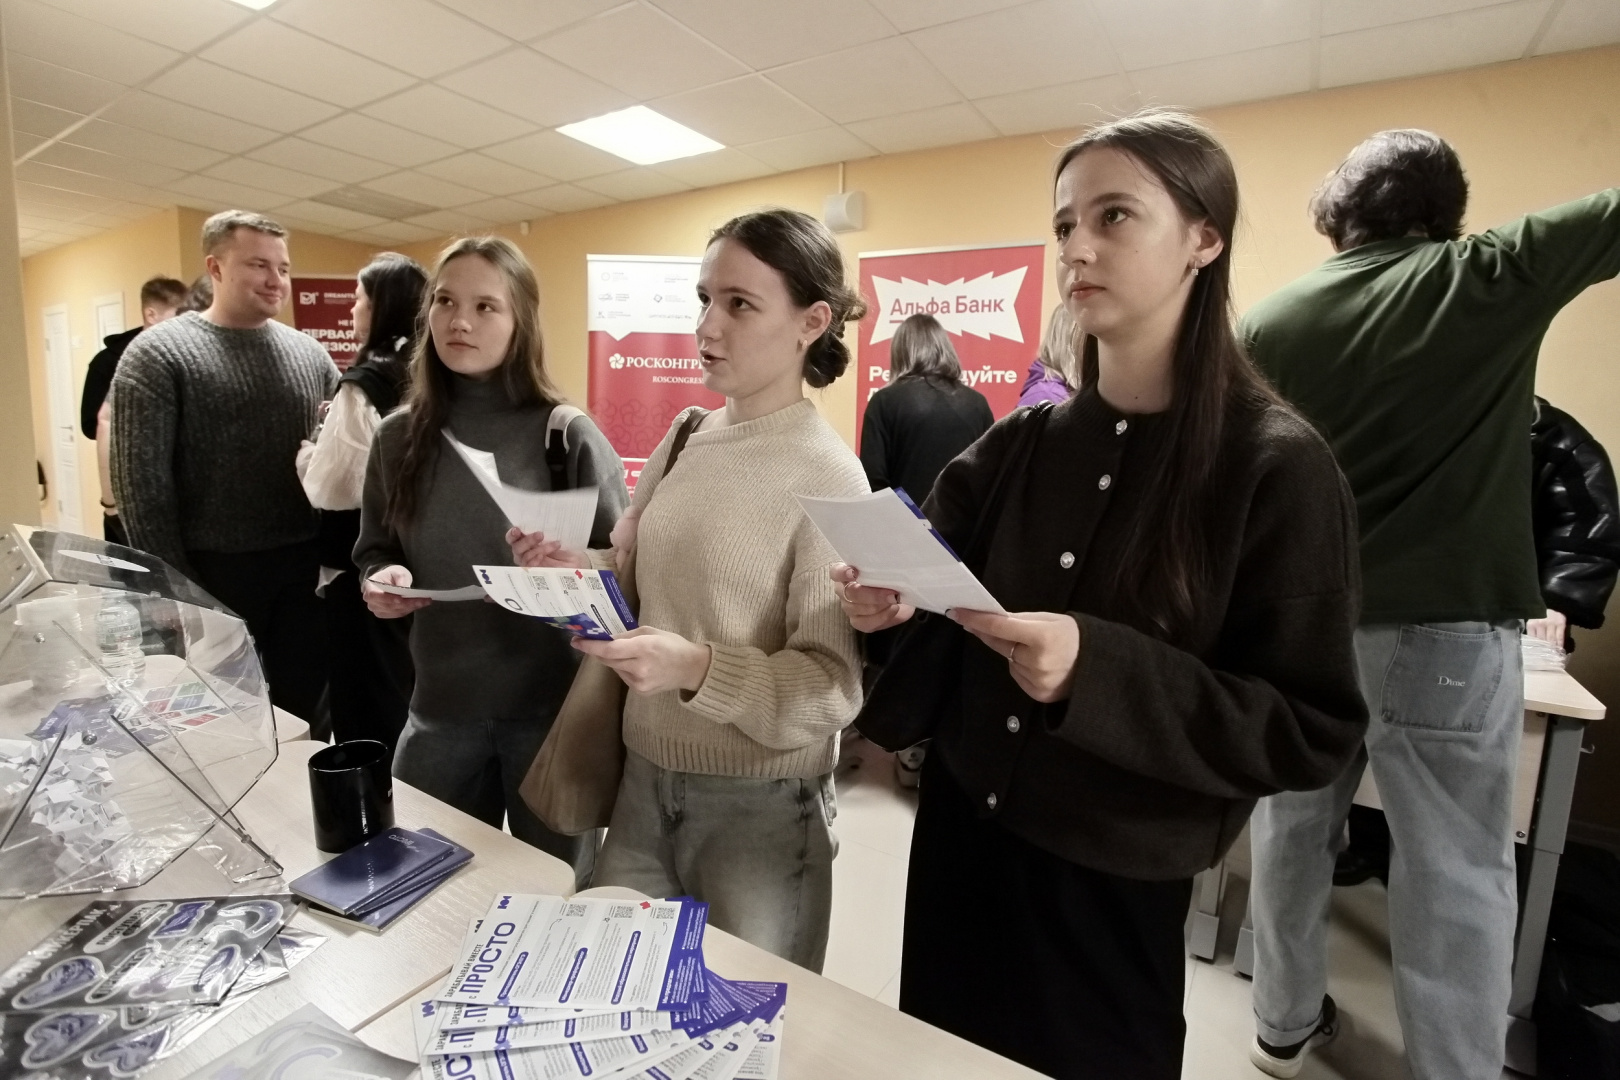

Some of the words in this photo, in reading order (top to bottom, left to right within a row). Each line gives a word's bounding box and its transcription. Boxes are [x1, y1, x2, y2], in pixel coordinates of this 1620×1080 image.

[890, 297, 950, 316] Альфа
[955, 295, 1005, 313] Банк
[323, 341, 362, 352] ЕЗЮМ
[1437, 675, 1466, 687] Dime
[458, 922, 517, 992] ПРОСТО
[444, 962, 473, 997] ЗАРАБАТЫВАЙ
[467, 943, 484, 961] ВМЕСТЕ
